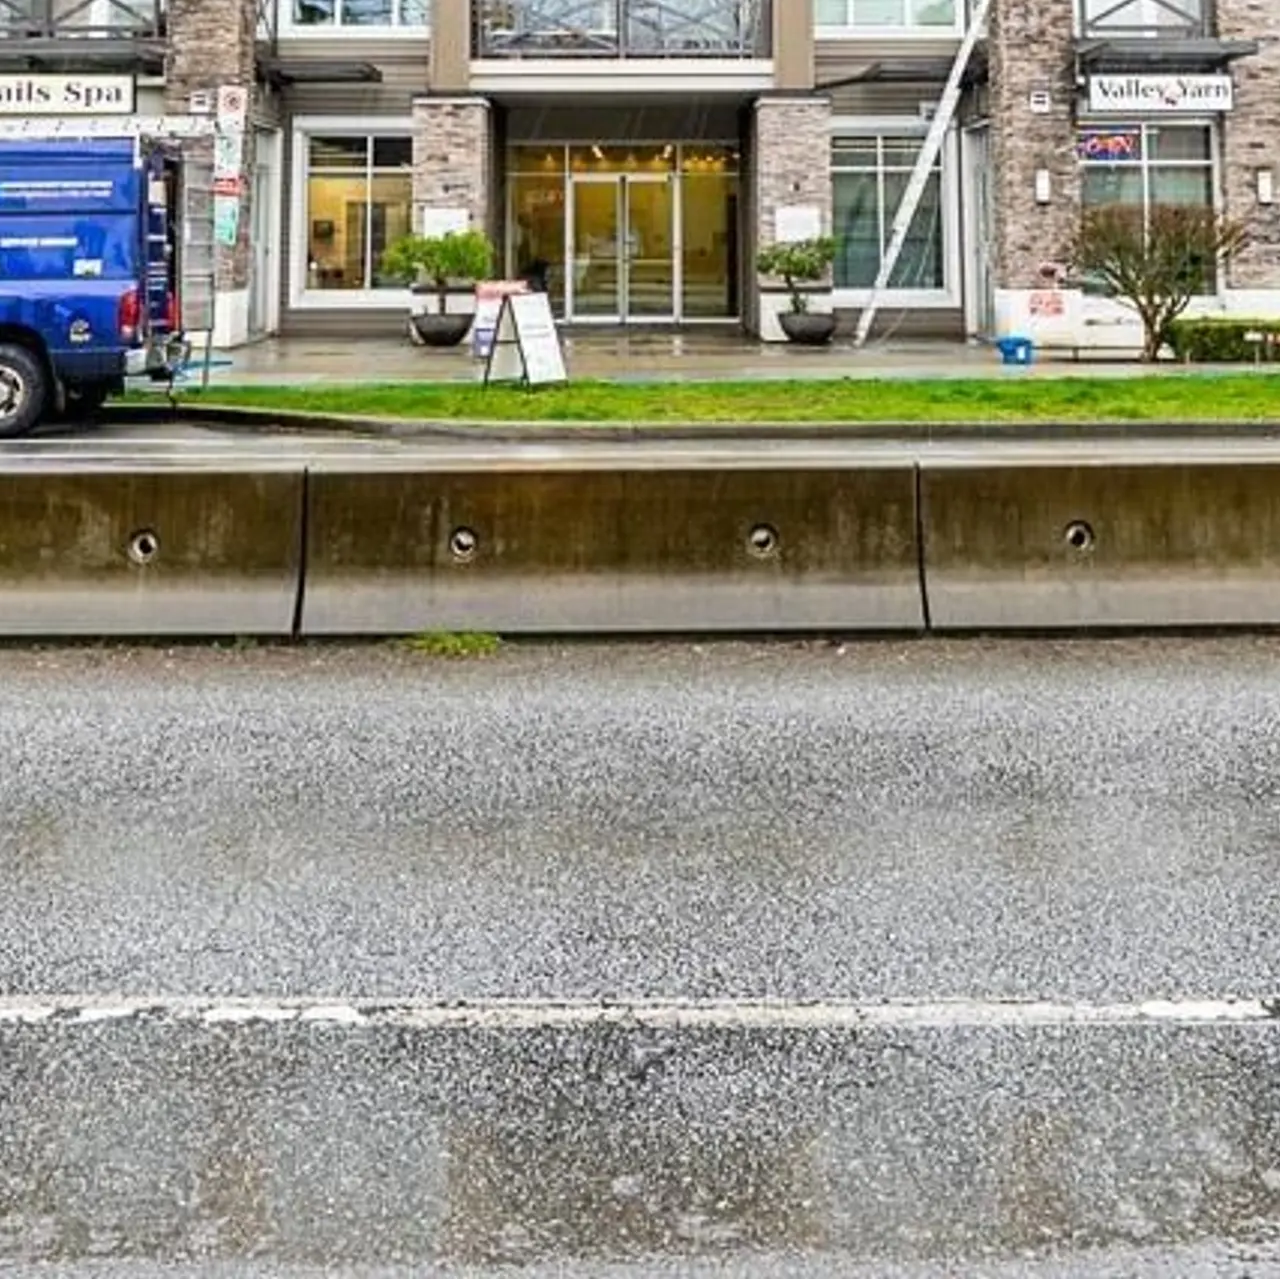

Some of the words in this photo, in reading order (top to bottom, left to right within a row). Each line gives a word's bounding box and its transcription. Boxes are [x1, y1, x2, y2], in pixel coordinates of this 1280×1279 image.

[63, 82, 124, 107] Spa
[1097, 78, 1166, 99] Valley
[1176, 78, 1230, 98] Yarn
